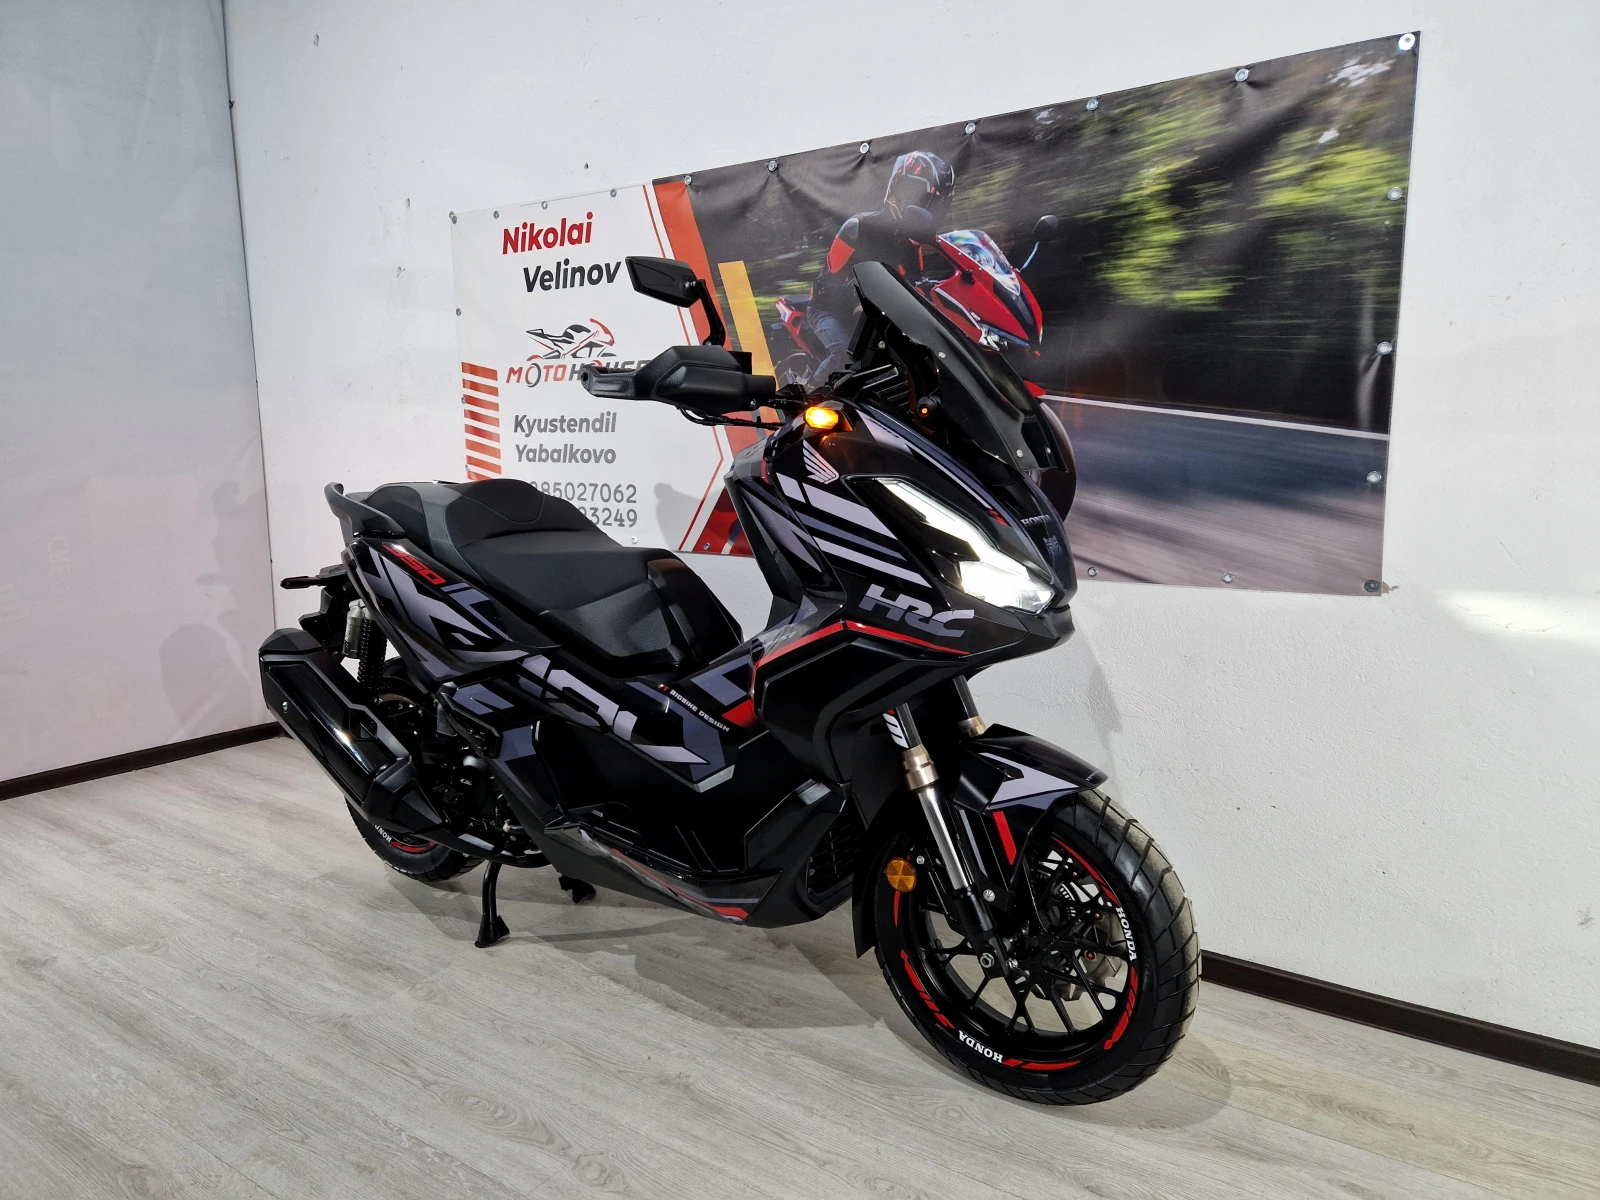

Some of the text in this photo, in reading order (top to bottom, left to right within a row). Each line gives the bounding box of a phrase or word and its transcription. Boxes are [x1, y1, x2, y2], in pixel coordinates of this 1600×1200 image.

[502, 211, 594, 255] Nikolai
[523, 258, 622, 293] Velinov
[505, 362, 567, 388] MOTO
[513, 411, 617, 437] Kyustendil
[515, 444, 617, 464] Yabalkovo
[858, 583, 975, 638] HRC
[669, 689, 699, 712] BIGBIKE
[698, 710, 730, 733] DESIGN
[1115, 906, 1137, 962] HONDA
[958, 1029, 1004, 1064] HONDA
